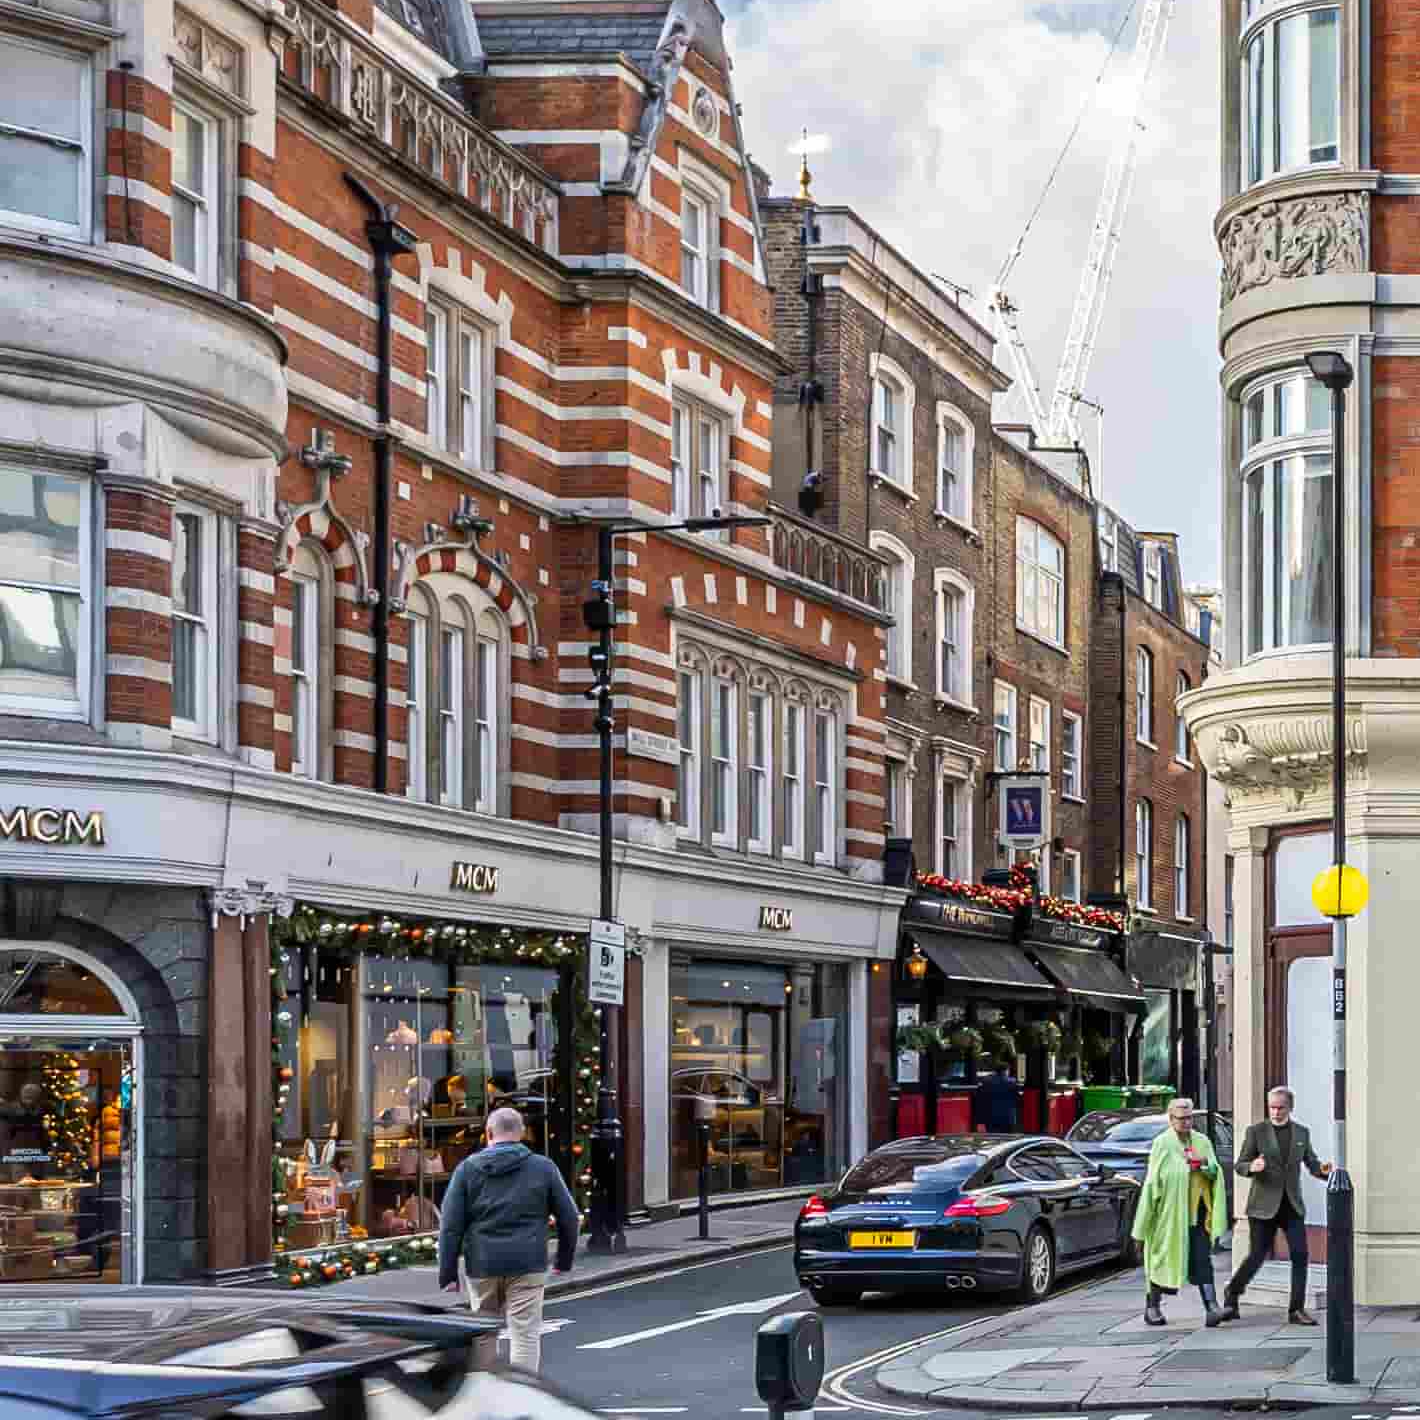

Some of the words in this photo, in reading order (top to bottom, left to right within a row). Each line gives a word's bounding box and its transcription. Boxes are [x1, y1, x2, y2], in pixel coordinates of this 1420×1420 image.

[0, 806, 105, 844] MCM
[452, 861, 498, 892] MCM
[760, 906, 793, 930] MCM
